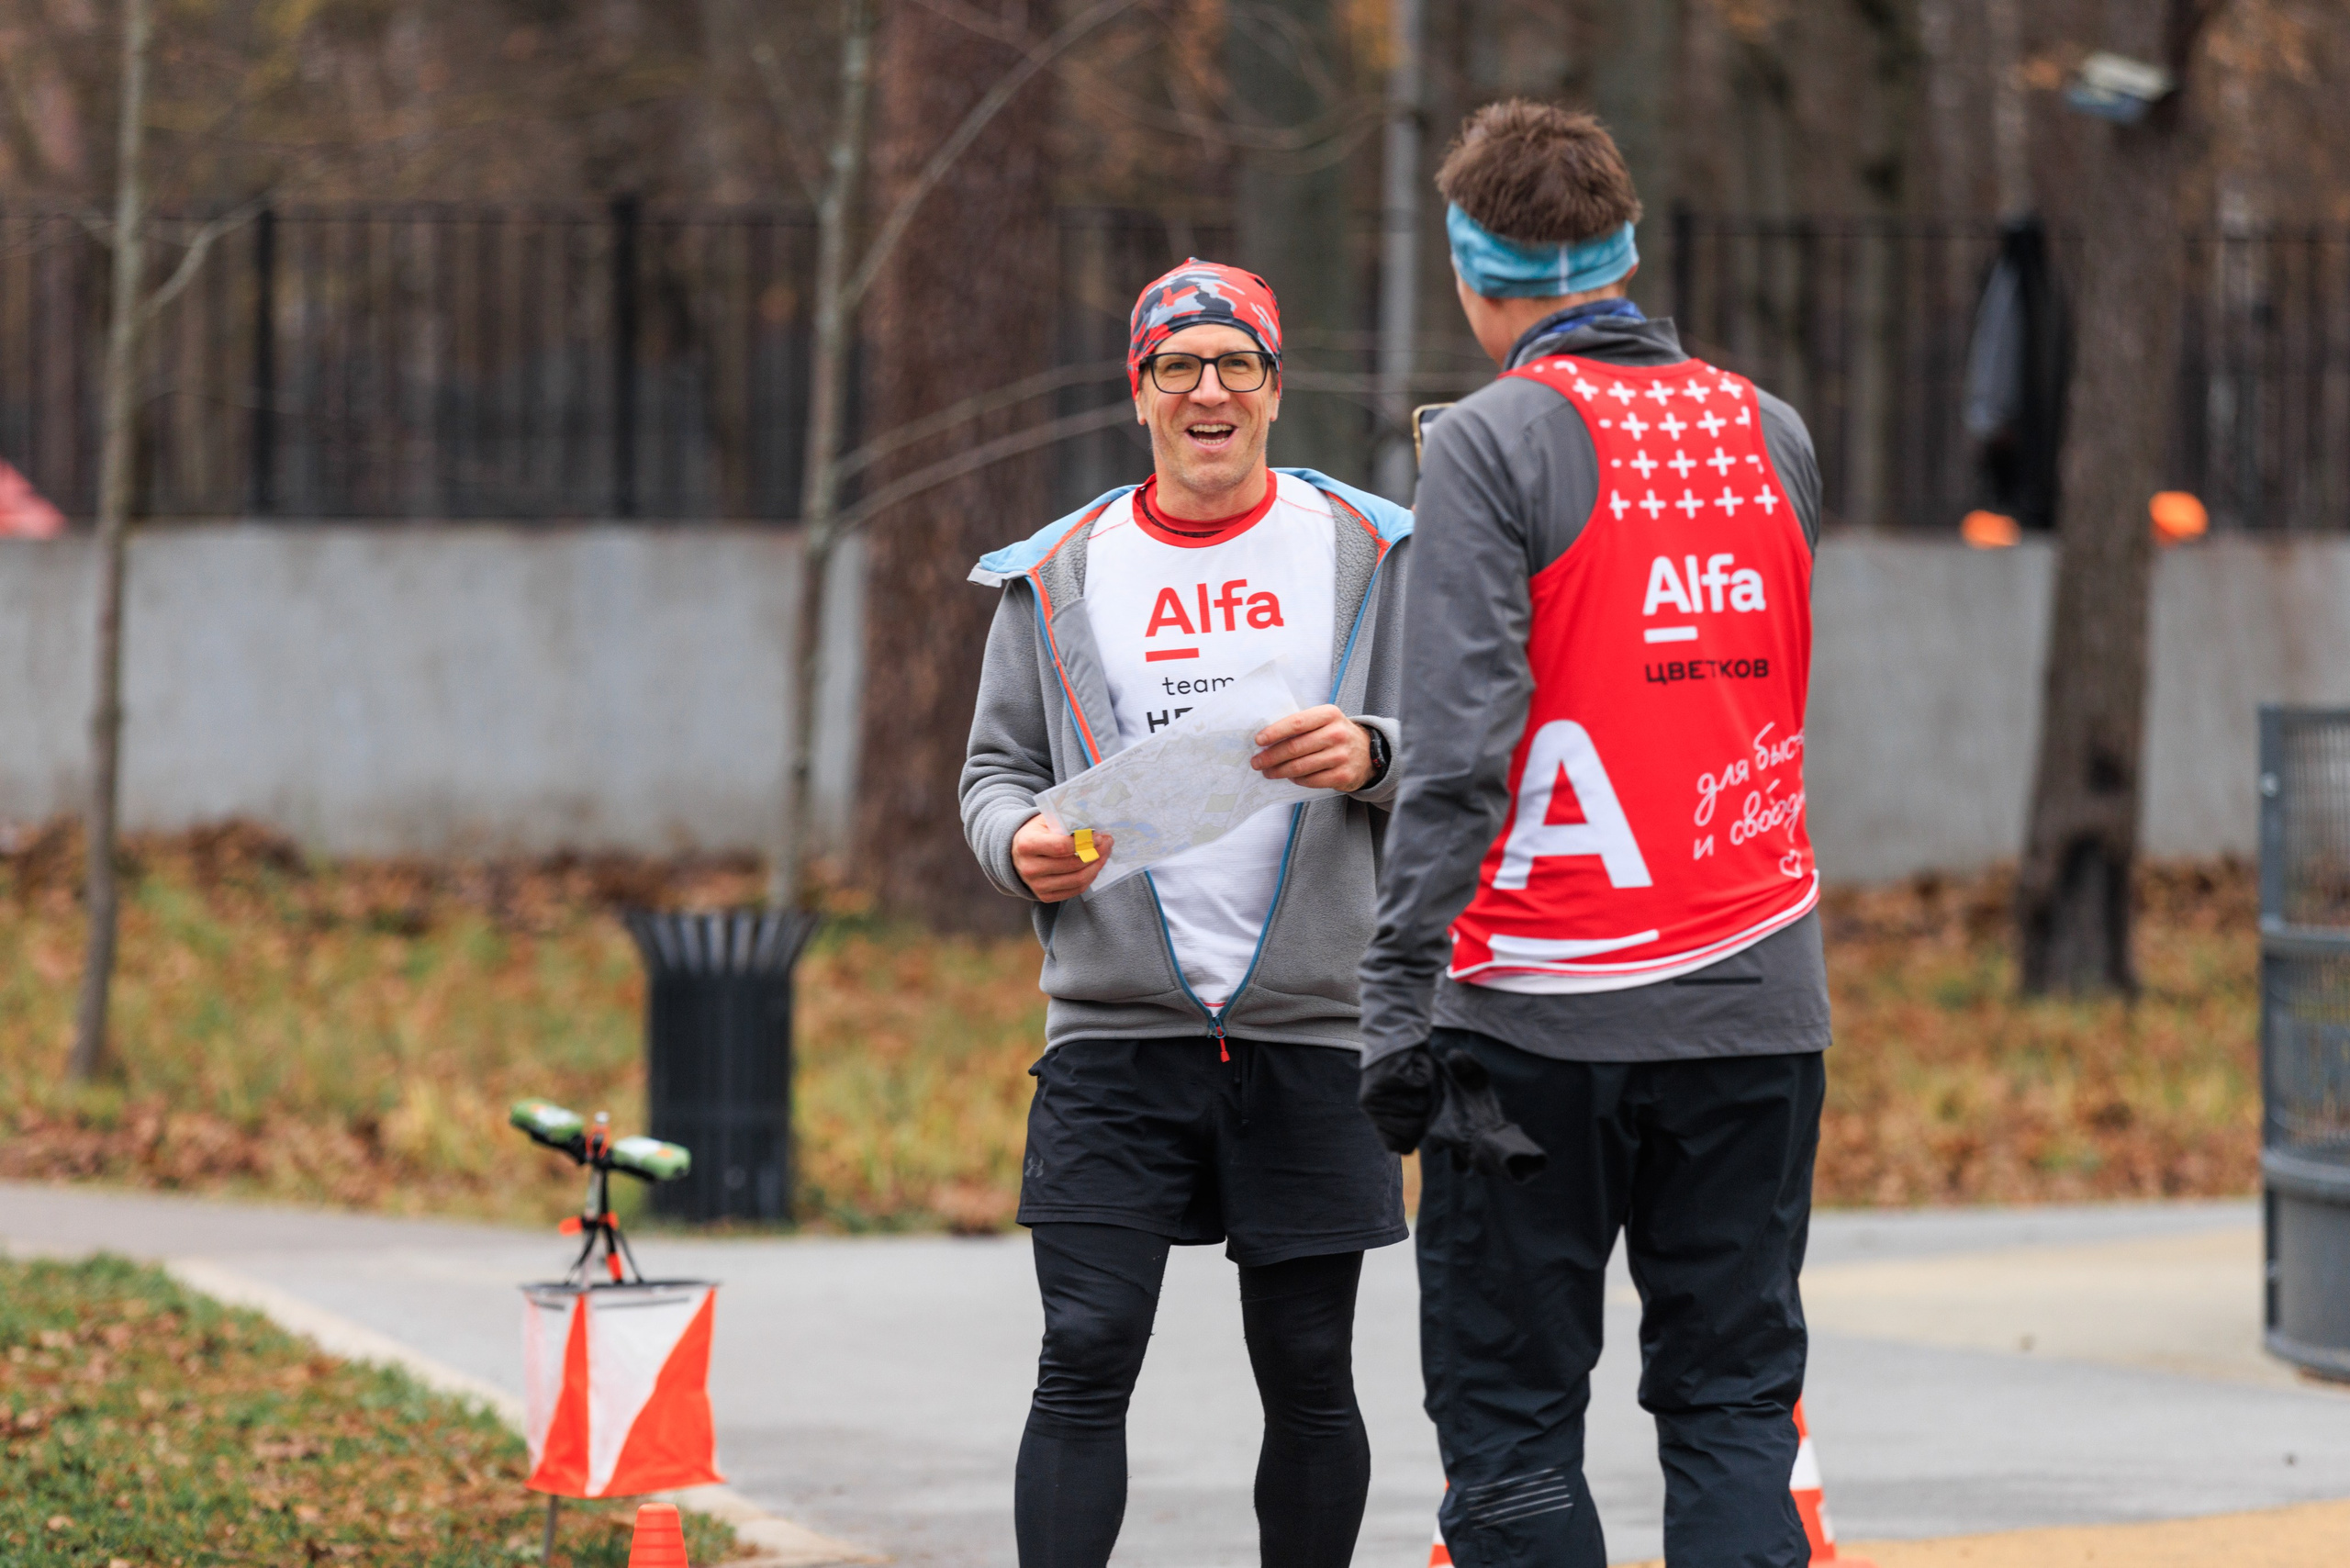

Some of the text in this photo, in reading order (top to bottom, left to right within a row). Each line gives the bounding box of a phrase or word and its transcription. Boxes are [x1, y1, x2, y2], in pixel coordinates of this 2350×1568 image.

[1643, 553, 1766, 616] Alfa
[1145, 578, 1284, 637] Alfa
[1162, 677, 1235, 695] team
[1645, 658, 1769, 685] ЦВЕТКОВ
[1694, 758, 1750, 827] для
[1693, 834, 1714, 860] и
